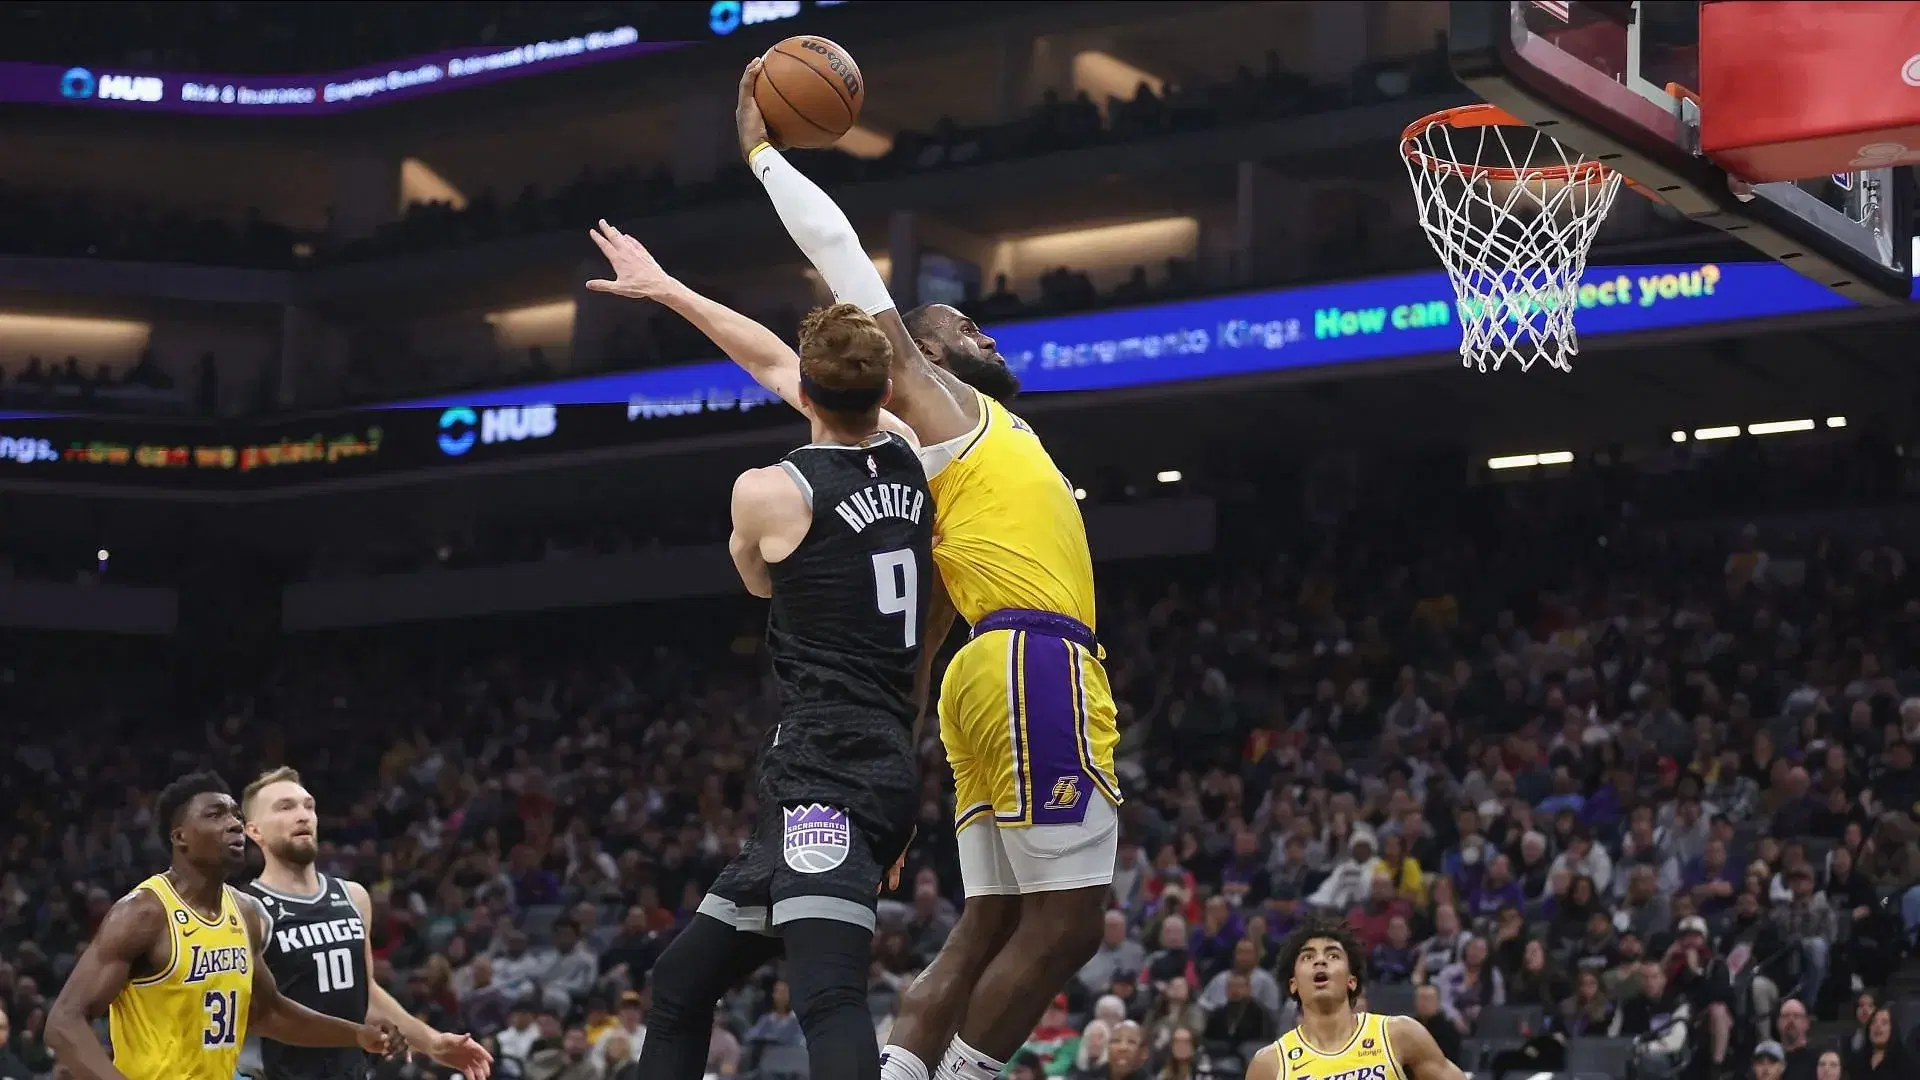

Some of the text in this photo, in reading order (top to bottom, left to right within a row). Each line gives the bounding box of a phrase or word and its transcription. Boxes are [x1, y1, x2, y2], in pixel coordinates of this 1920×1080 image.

[99, 74, 163, 101] HUB
[627, 390, 703, 422] Proud
[707, 386, 736, 412] to
[1040, 329, 1211, 370] Sacramento
[1314, 306, 1388, 341] How
[1391, 300, 1451, 331] can
[1638, 264, 1721, 308] you?
[481, 403, 558, 444] HUB
[834, 483, 925, 534] HUERTER
[871, 547, 918, 649] 9
[786, 830, 847, 850] KINGS
[787, 821, 846, 833] SACRAMENTO
[275, 917, 366, 953] KINGS
[184, 945, 248, 983] LAKERS
[312, 948, 355, 993] 10
[203, 990, 237, 1046] 31
